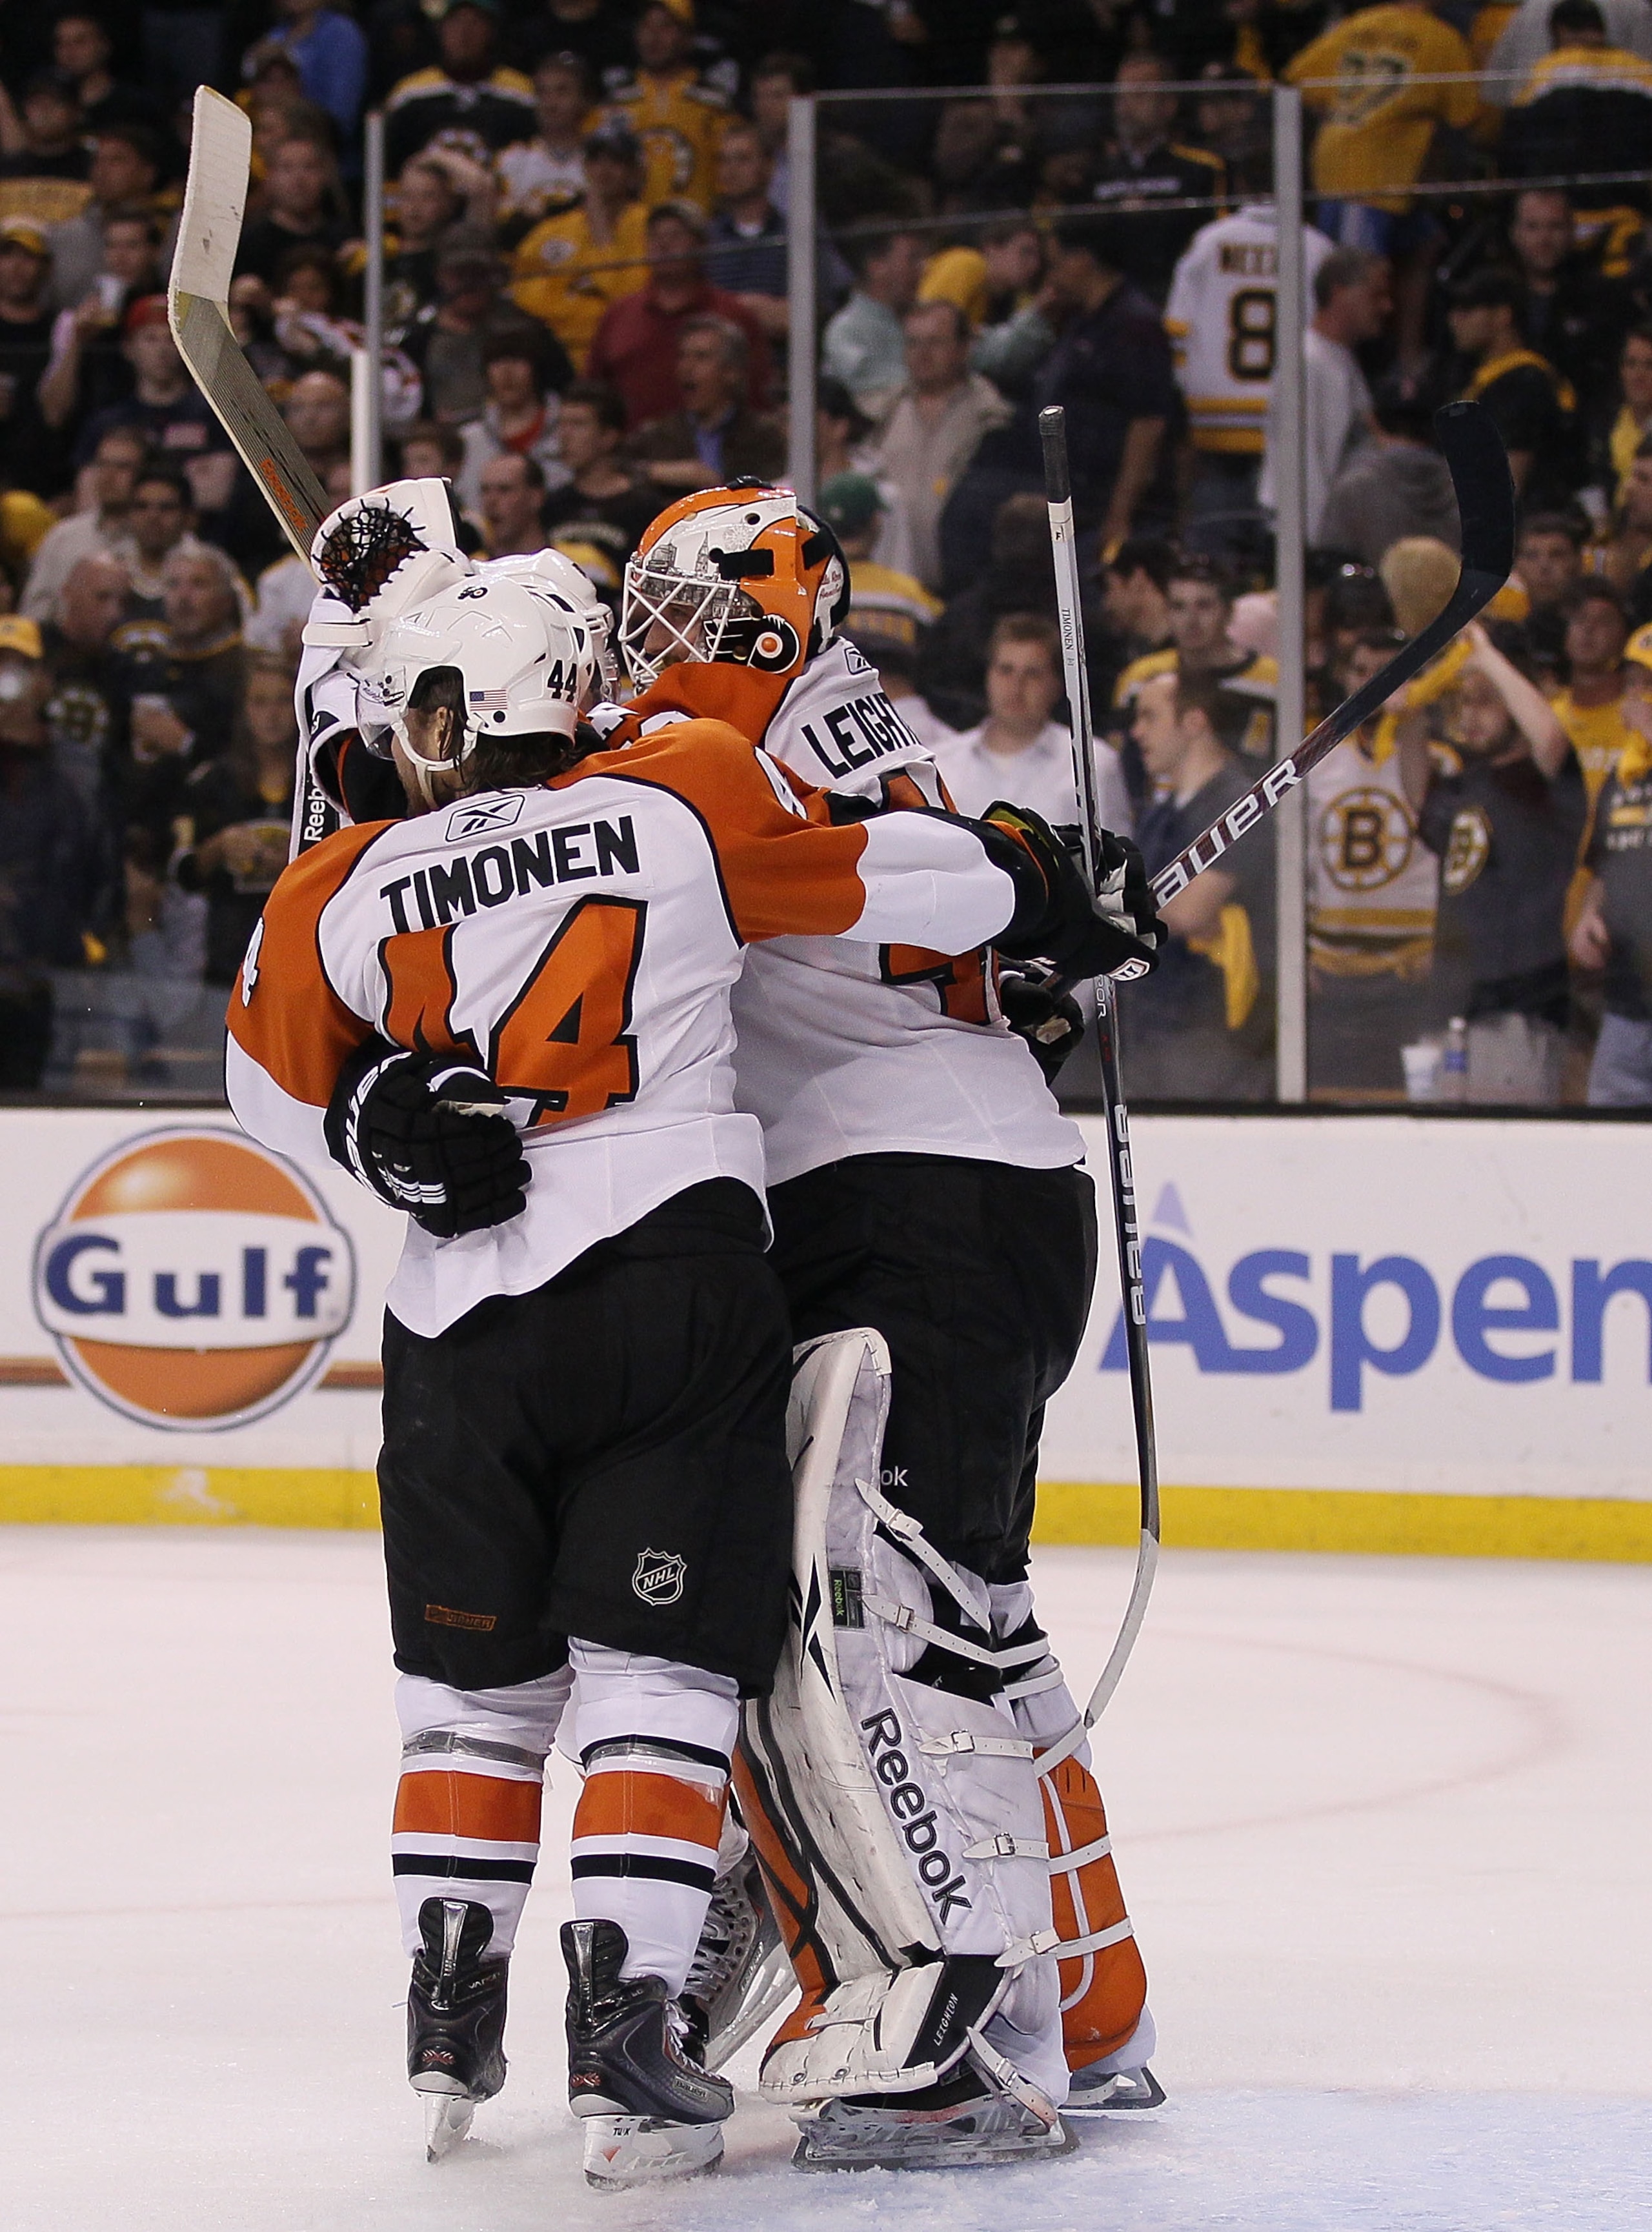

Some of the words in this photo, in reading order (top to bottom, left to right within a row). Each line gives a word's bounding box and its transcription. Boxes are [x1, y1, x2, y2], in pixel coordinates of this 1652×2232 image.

[1062, 608, 1074, 650] TIMONEN
[548, 659, 578, 703] 44
[379, 815, 641, 934] TIMONEN
[46, 1235, 332, 1318] Gulf
[1098, 1180, 1652, 1413] Aspen
[643, 1567, 675, 1589] NHL
[834, 1579, 845, 1616] Reebok
[861, 1708, 972, 1926] Reebok
[933, 1992, 958, 2046] LEIGHTON
